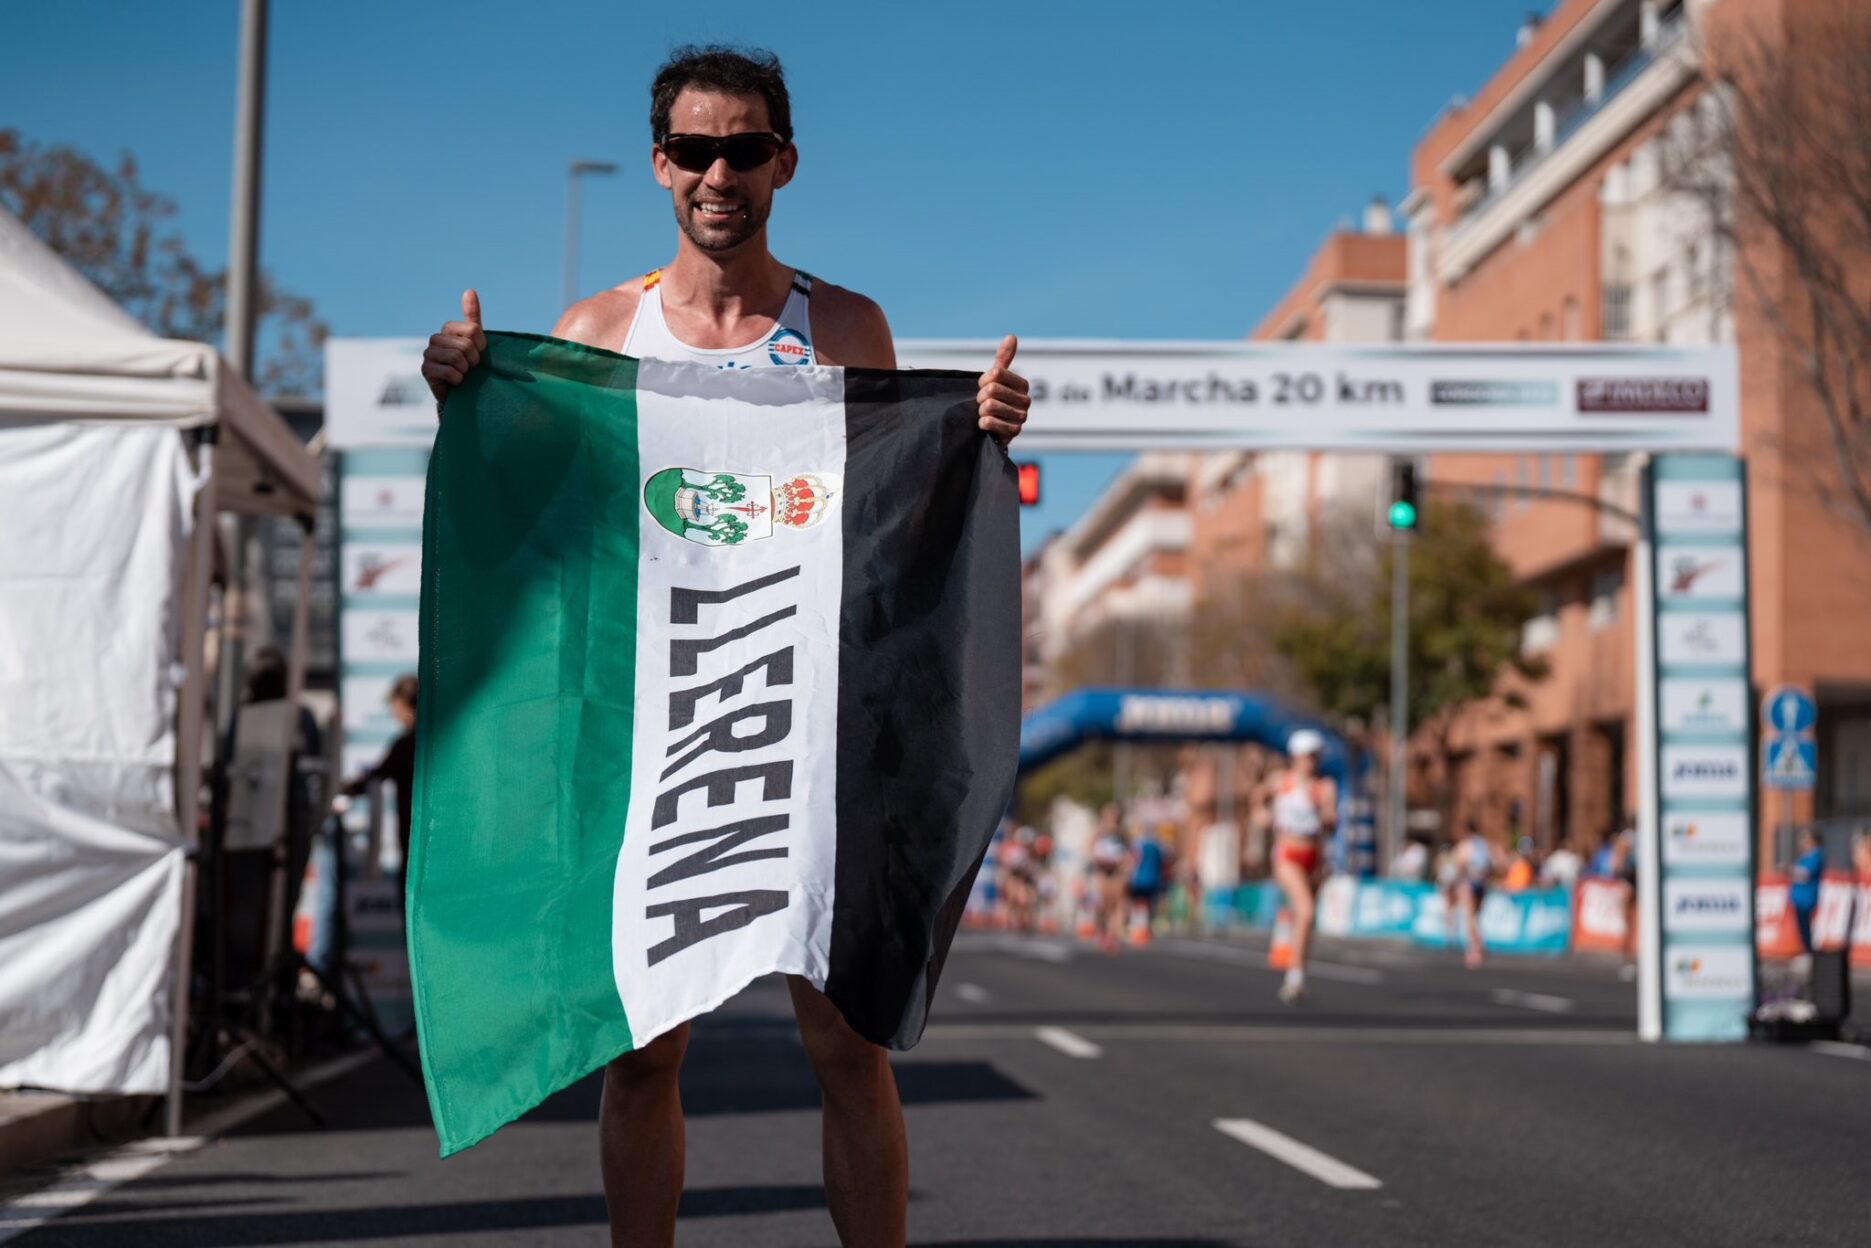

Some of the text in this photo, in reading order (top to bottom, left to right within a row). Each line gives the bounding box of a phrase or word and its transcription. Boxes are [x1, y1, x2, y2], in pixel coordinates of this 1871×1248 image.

[1102, 371, 1258, 403] Marcha
[1270, 371, 1325, 403] 20
[1335, 369, 1405, 403] km
[646, 565, 800, 968] LLERENA
